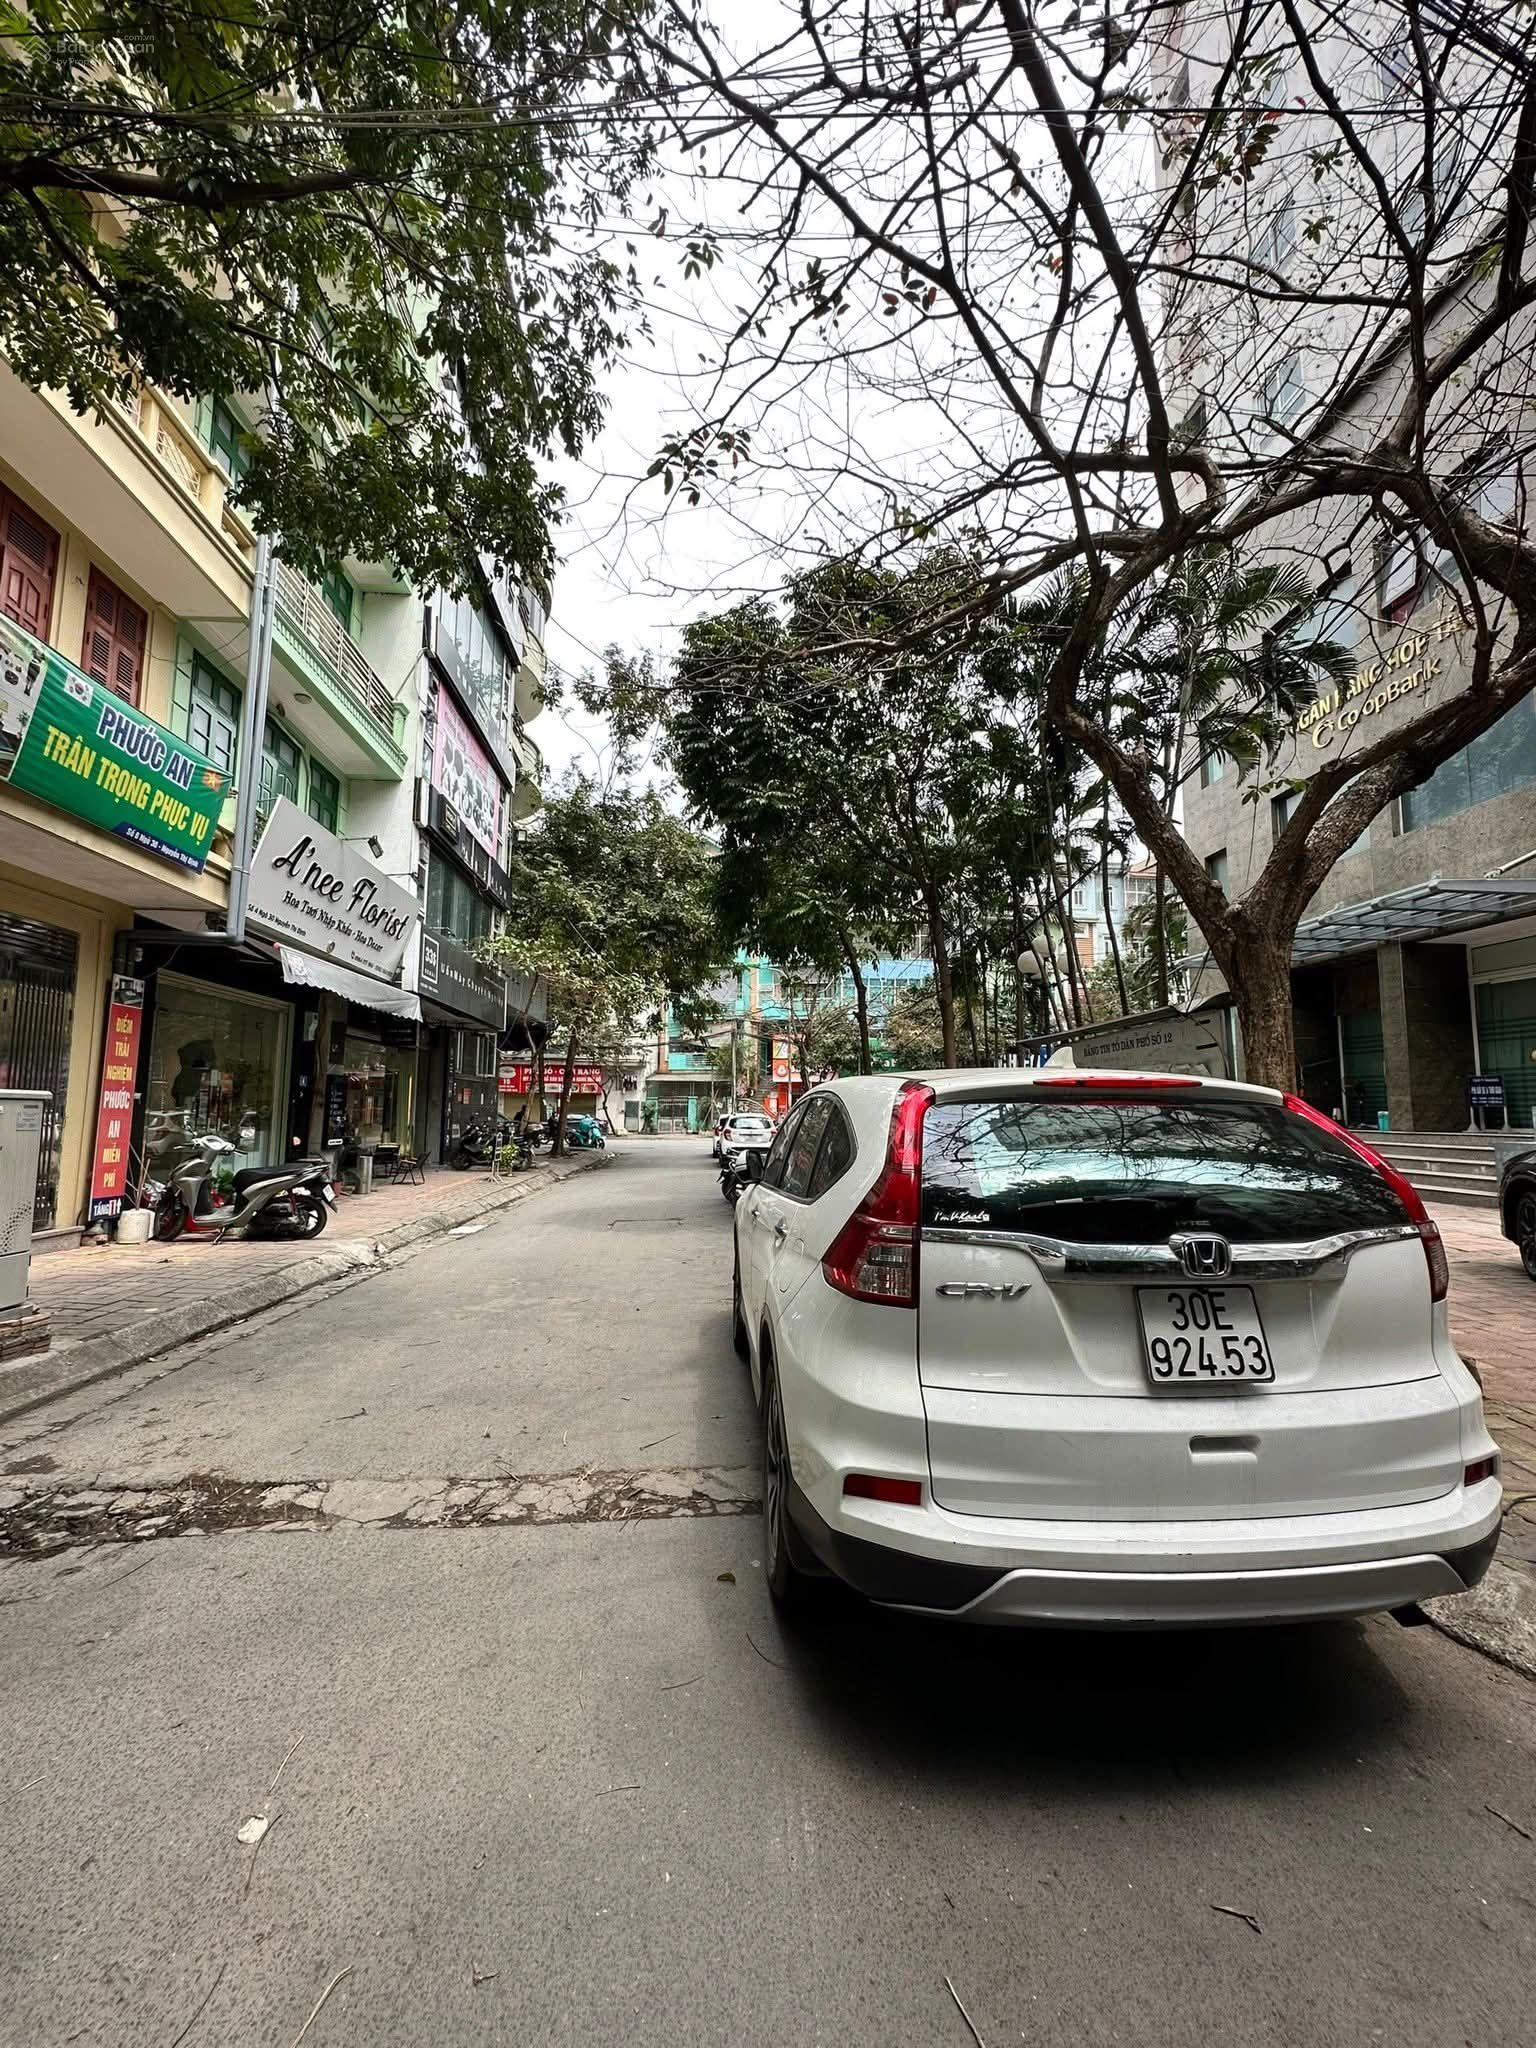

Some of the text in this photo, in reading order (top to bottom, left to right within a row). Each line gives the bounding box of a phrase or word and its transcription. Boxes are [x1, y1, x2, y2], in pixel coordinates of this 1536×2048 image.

[1296, 694, 1331, 731] GÂN
[97, 704, 196, 791] PHƯỚC AN
[43, 726, 210, 845] TRÂN TRỌNG PHỤC VỤ
[272, 836, 410, 941] A'nee Florist
[283, 890, 300, 909] Hoa
[1164, 1032, 1173, 1044] 12
[103, 1086, 131, 1109] PHƯỚC
[108, 1120, 121, 1138] AN
[103, 1169, 117, 1188] PHÍ
[936, 1281, 1033, 1298] CR-V
[1168, 1291, 1234, 1331] 30E
[1150, 1335, 1267, 1377] 924.53
